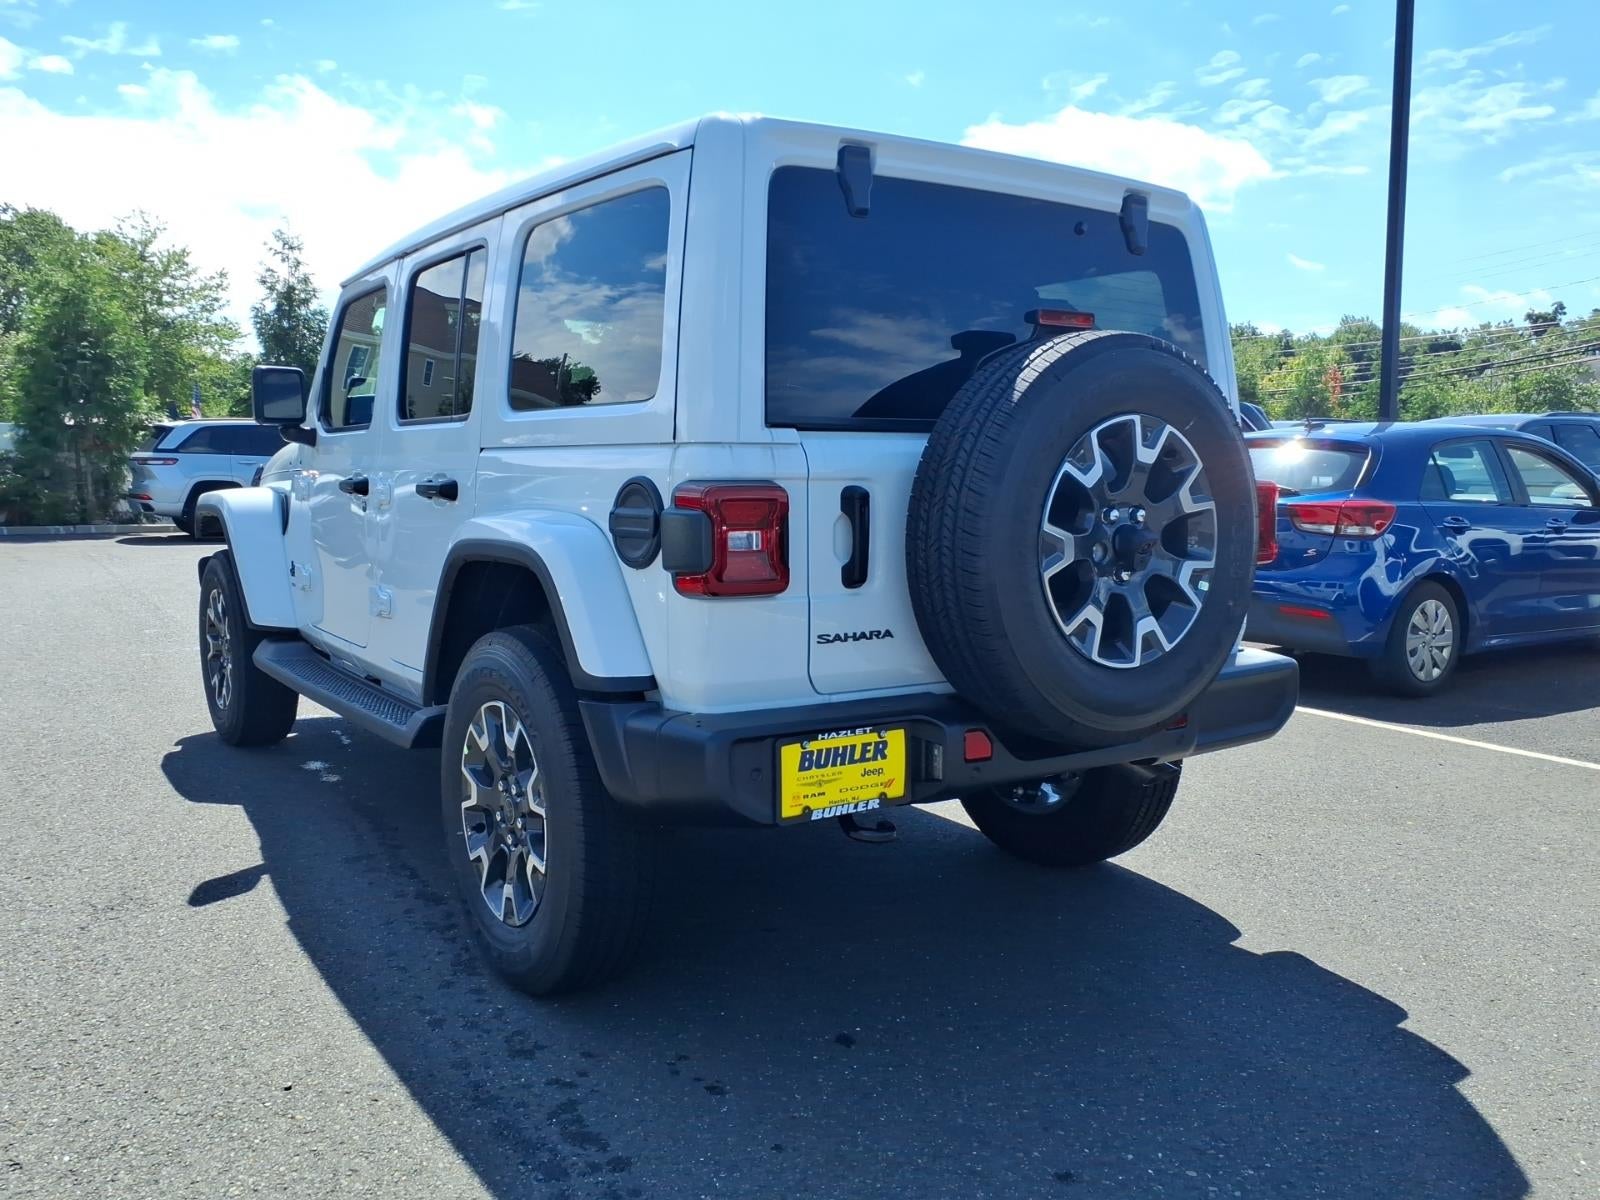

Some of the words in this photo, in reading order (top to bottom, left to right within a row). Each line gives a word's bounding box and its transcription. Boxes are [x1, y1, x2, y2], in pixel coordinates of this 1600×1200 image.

[816, 629, 895, 644] SAHARA
[818, 727, 873, 740] HAZLET
[798, 740, 888, 772] BUHLER
[861, 767, 885, 778] Jeep
[839, 782, 886, 793] DODGE
[803, 791, 826, 800] RAM
[811, 799, 880, 820] BUHLER
